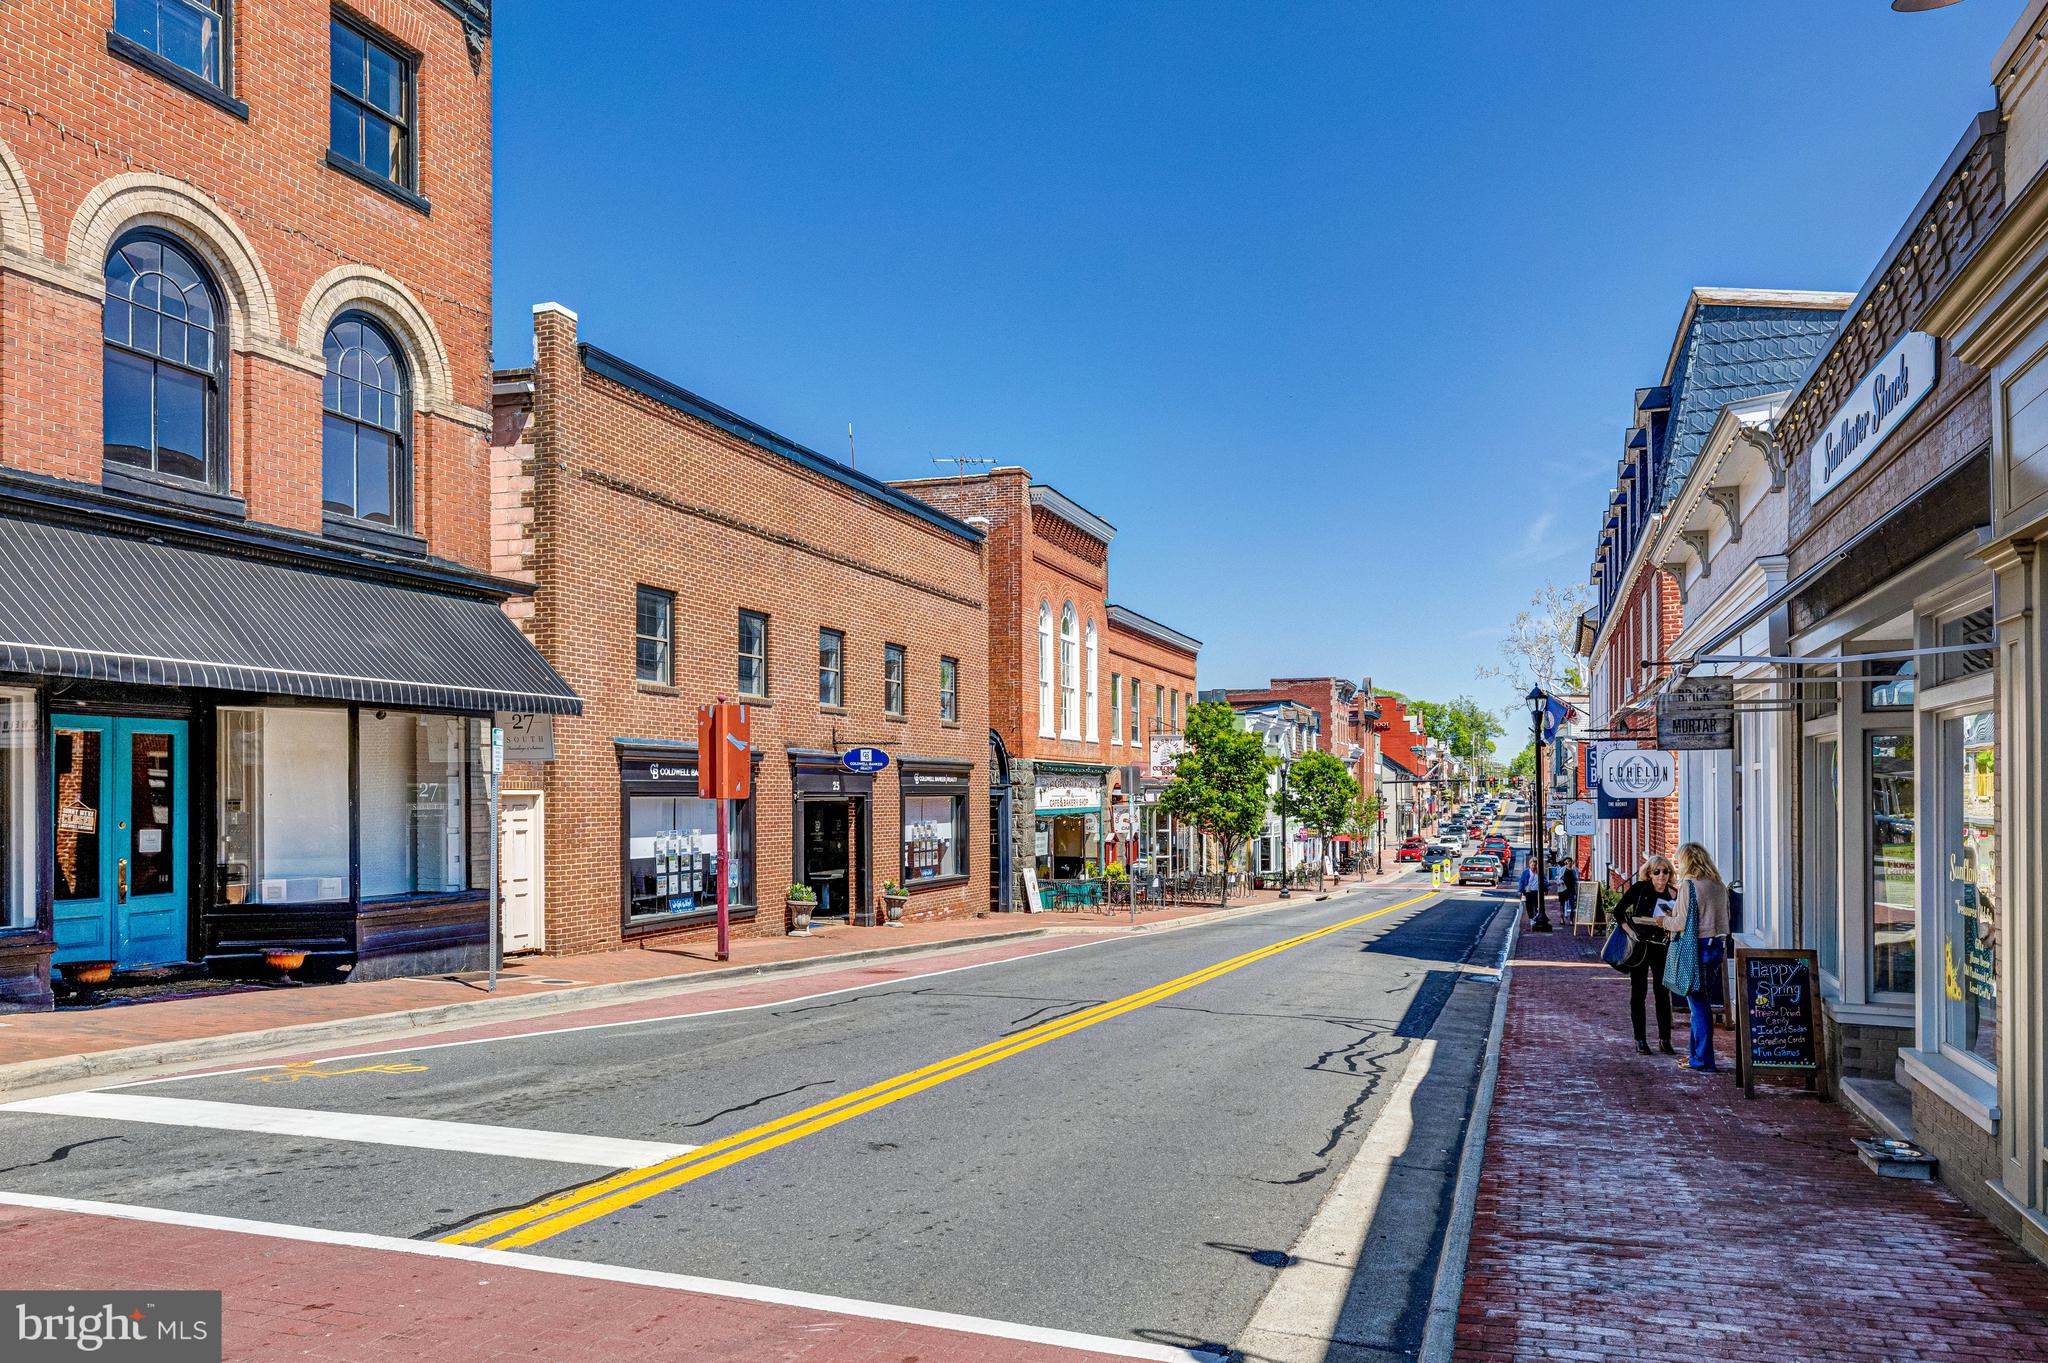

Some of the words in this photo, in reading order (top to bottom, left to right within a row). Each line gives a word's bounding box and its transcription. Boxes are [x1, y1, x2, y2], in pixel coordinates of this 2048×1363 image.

[1823, 410, 1870, 484] Sunflower
[1871, 353, 1909, 435] Shack
[1678, 687, 1710, 701] BRICK
[511, 713, 535, 734] 27
[1672, 718, 1717, 734] MORTAR
[506, 735, 544, 744] SOUTH
[659, 767, 690, 776] COLDWELL
[1609, 765, 1668, 782] ECHELON
[419, 782, 439, 802] 27
[832, 781, 840, 791] 25
[1568, 812, 1593, 820] SideBar
[1750, 960, 1802, 986] Happy
[1755, 980, 1802, 1007] Spring
[1754, 1006, 1779, 1017] Freeze
[1756, 1025, 1773, 1035] Ice
[1787, 1024, 1808, 1034] Sodas
[1757, 1047, 1773, 1057] Fun
[1773, 1046, 1801, 1057] Games
